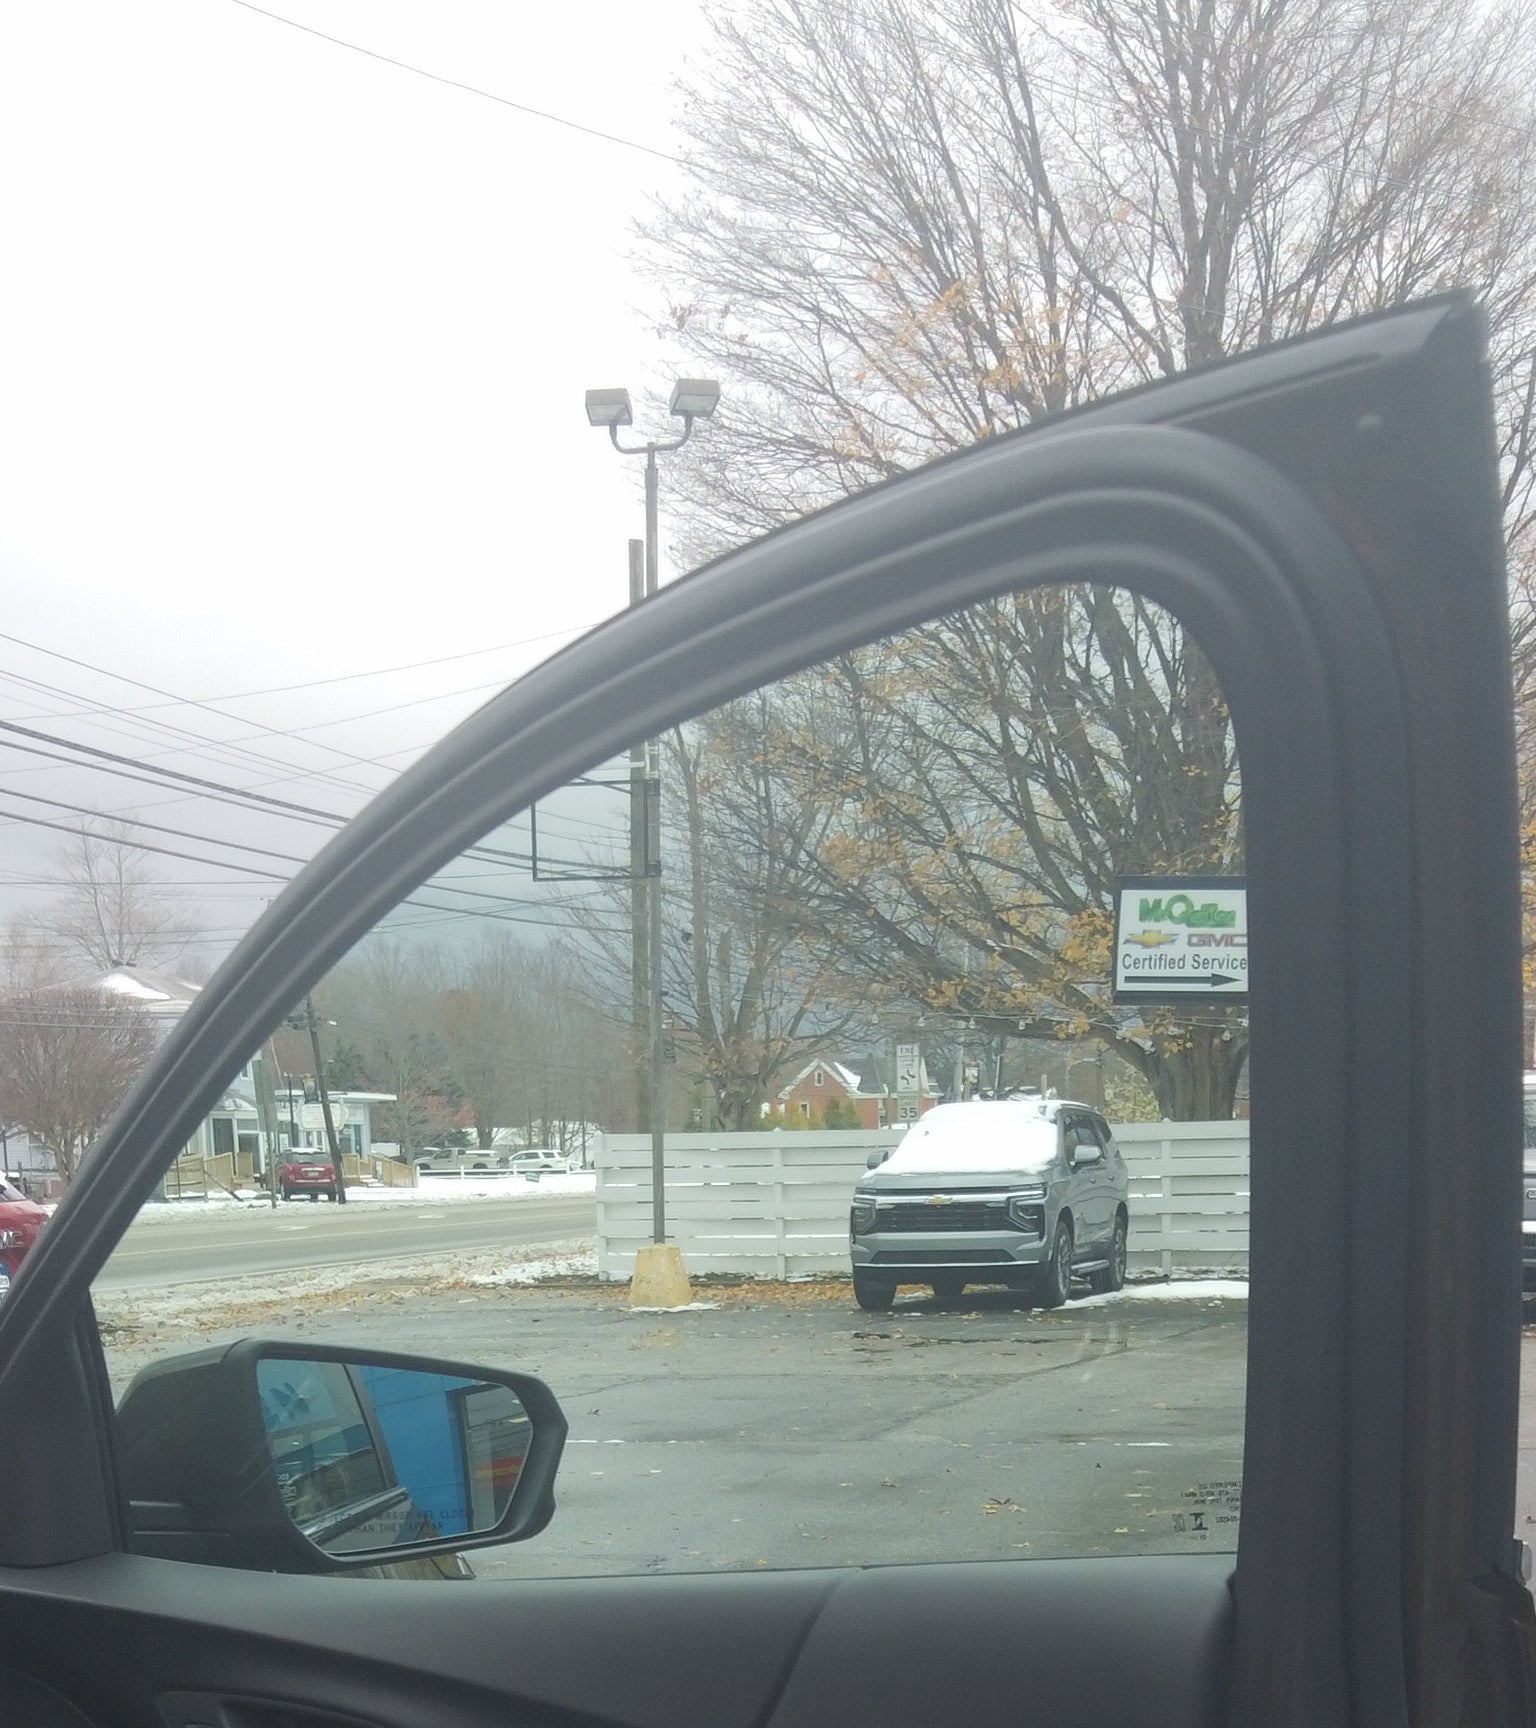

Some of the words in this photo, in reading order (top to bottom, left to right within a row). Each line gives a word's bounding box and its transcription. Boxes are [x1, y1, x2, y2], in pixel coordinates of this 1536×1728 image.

[1187, 933, 1247, 947] GMC
[1122, 953, 1185, 970] Certified
[1191, 953, 1247, 970] Service
[899, 1107, 918, 1119] 35
